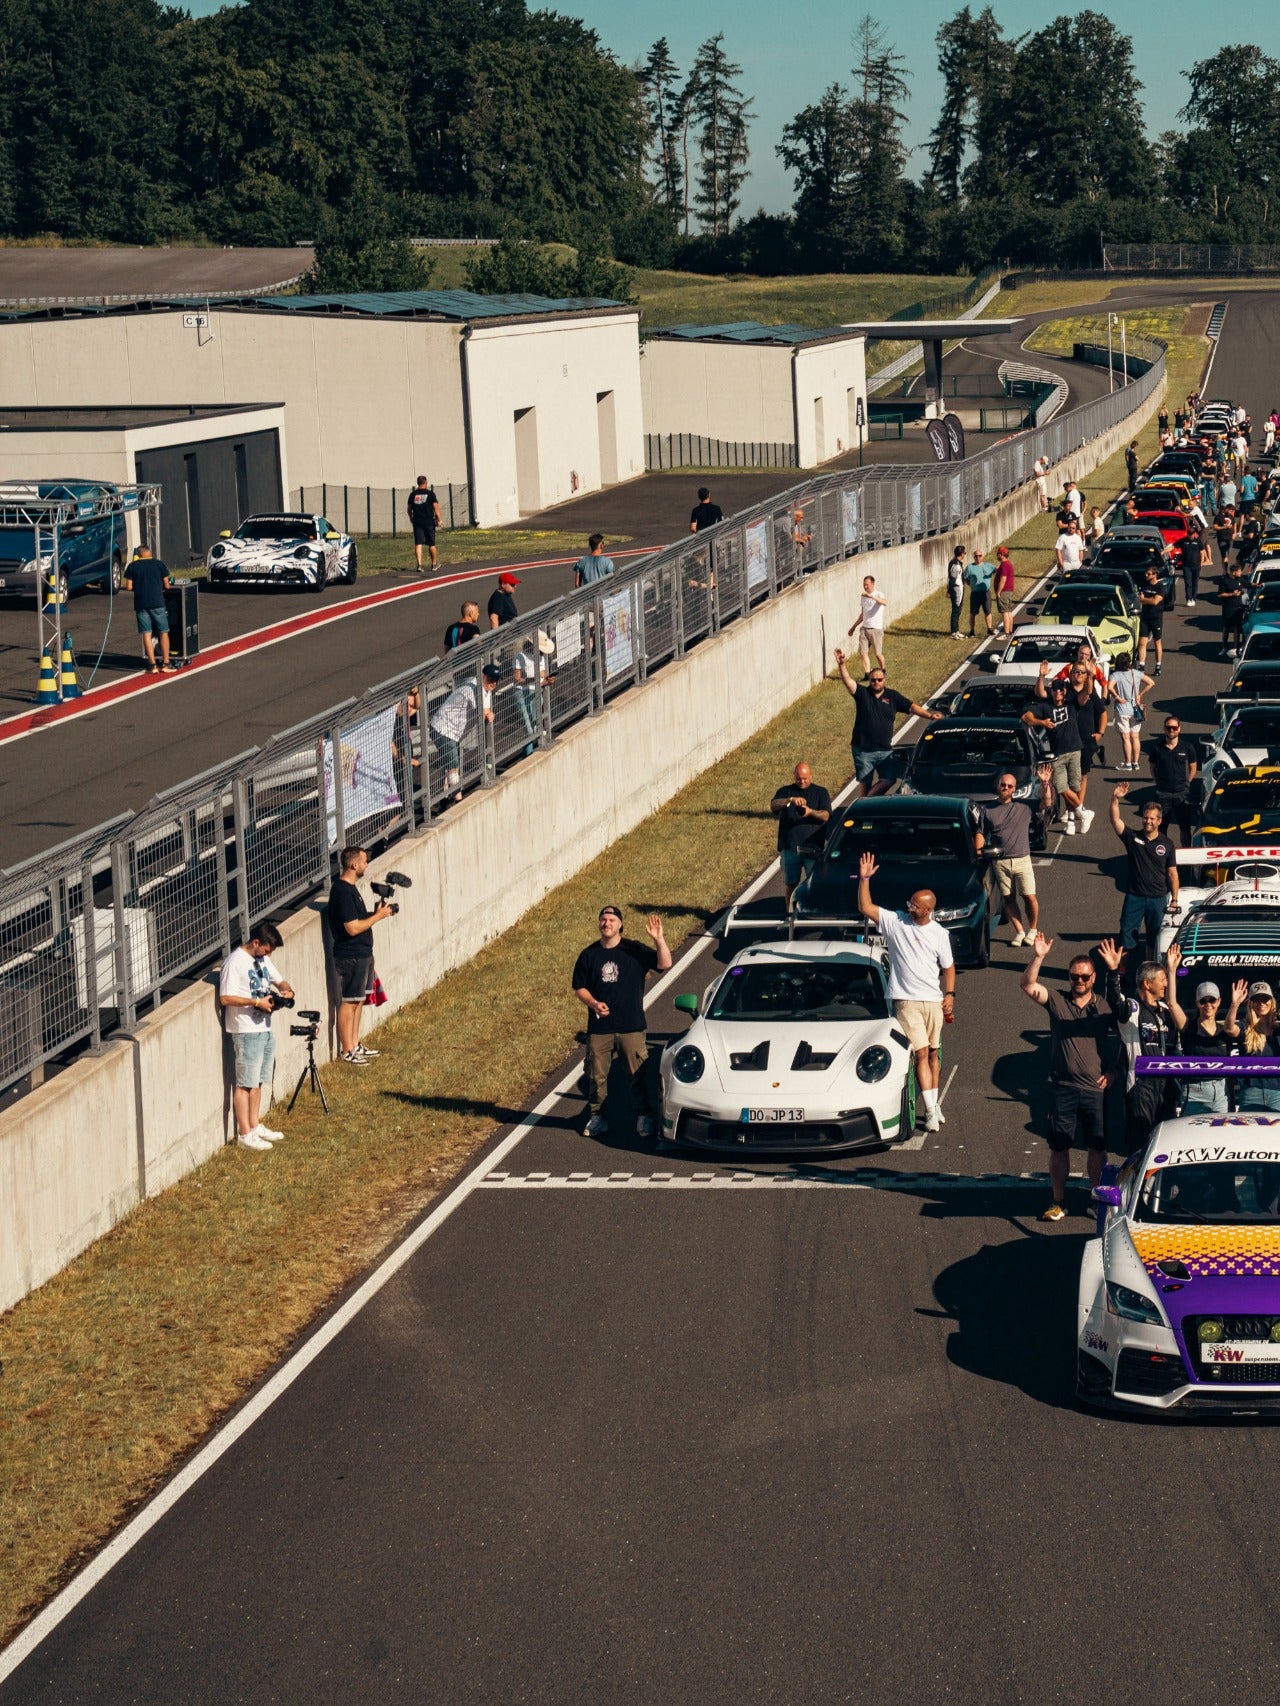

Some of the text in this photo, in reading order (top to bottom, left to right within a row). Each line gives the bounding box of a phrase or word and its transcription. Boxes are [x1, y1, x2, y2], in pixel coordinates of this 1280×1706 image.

[186, 317, 193, 325] C
[1207, 955, 1238, 964] GRAN
[1146, 1062, 1224, 1070] KW
[749, 1109, 803, 1121] DO JP 13
[1168, 1146, 1226, 1165] KW
[1213, 1350, 1244, 1362] KW
